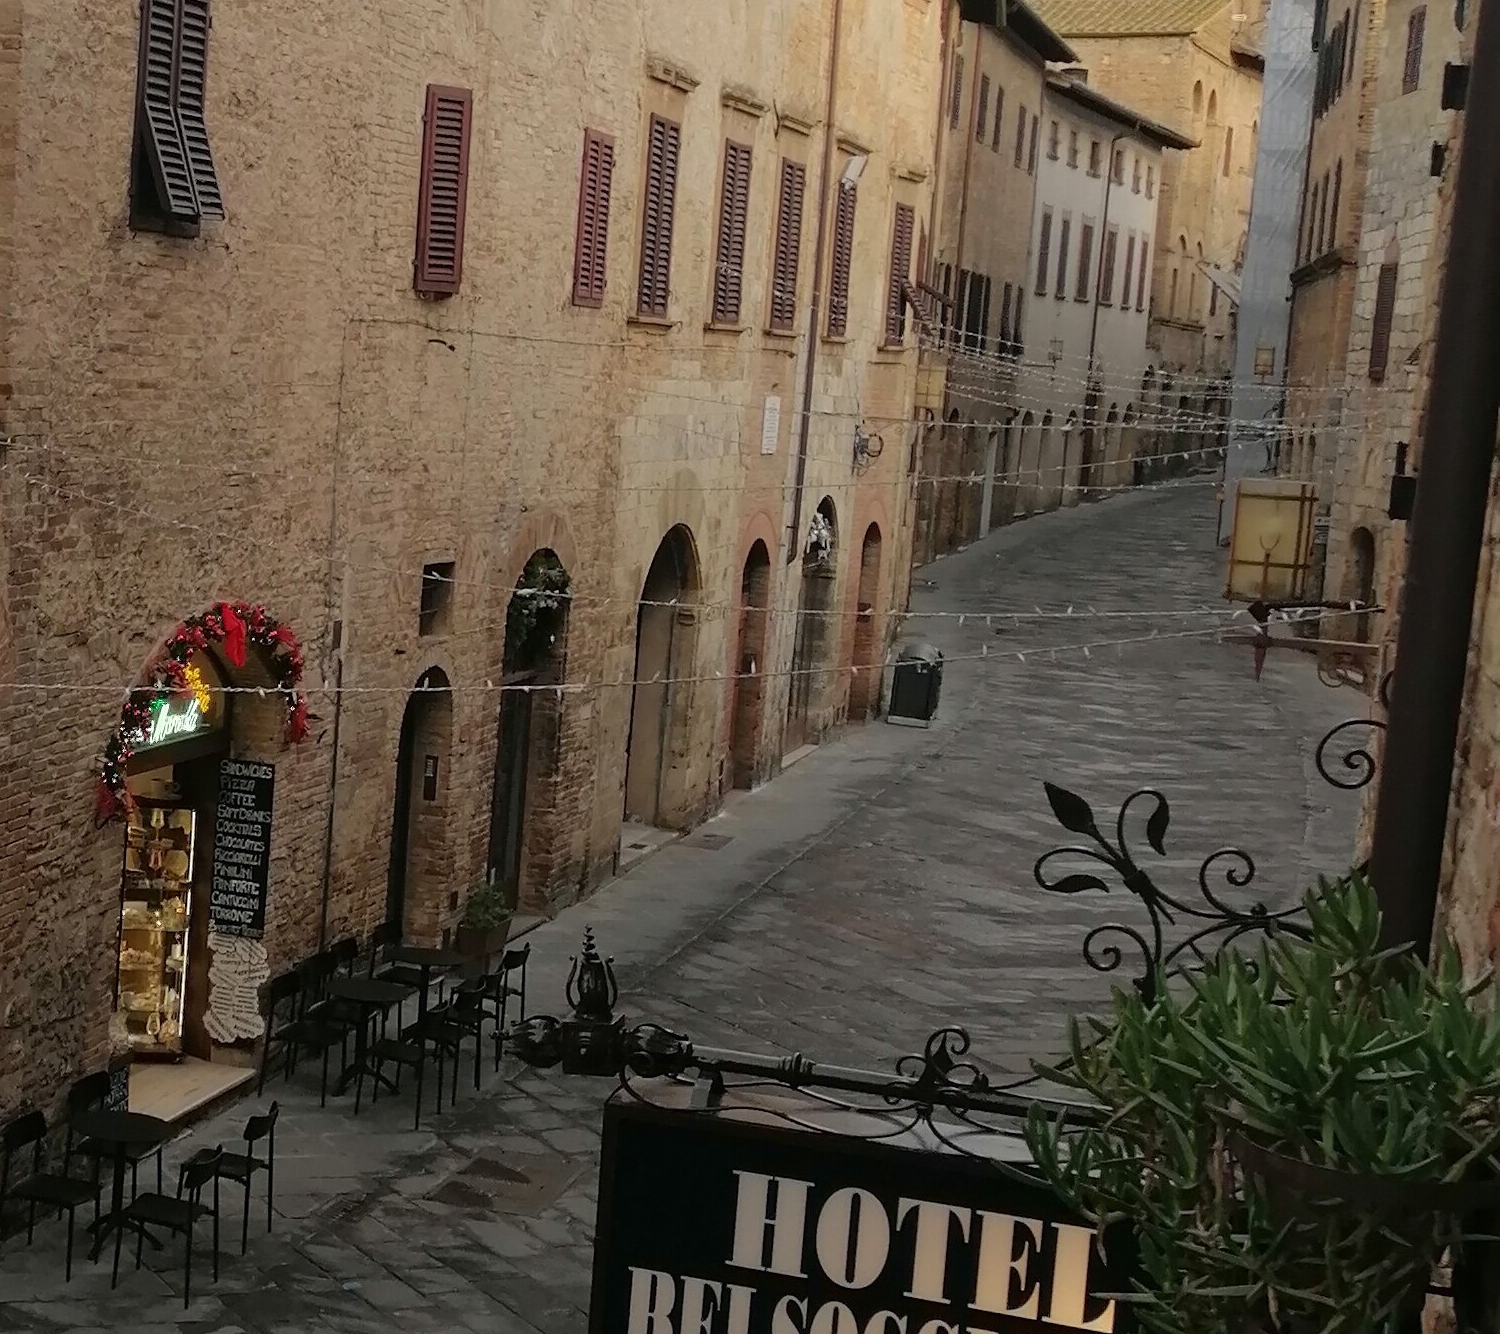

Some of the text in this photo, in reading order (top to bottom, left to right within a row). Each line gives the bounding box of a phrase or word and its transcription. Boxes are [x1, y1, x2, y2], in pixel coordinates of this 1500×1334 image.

[220, 775, 255, 791] PIZZA
[219, 790, 256, 806] COFFEE
[725, 1170, 1117, 1334] HOTEL
